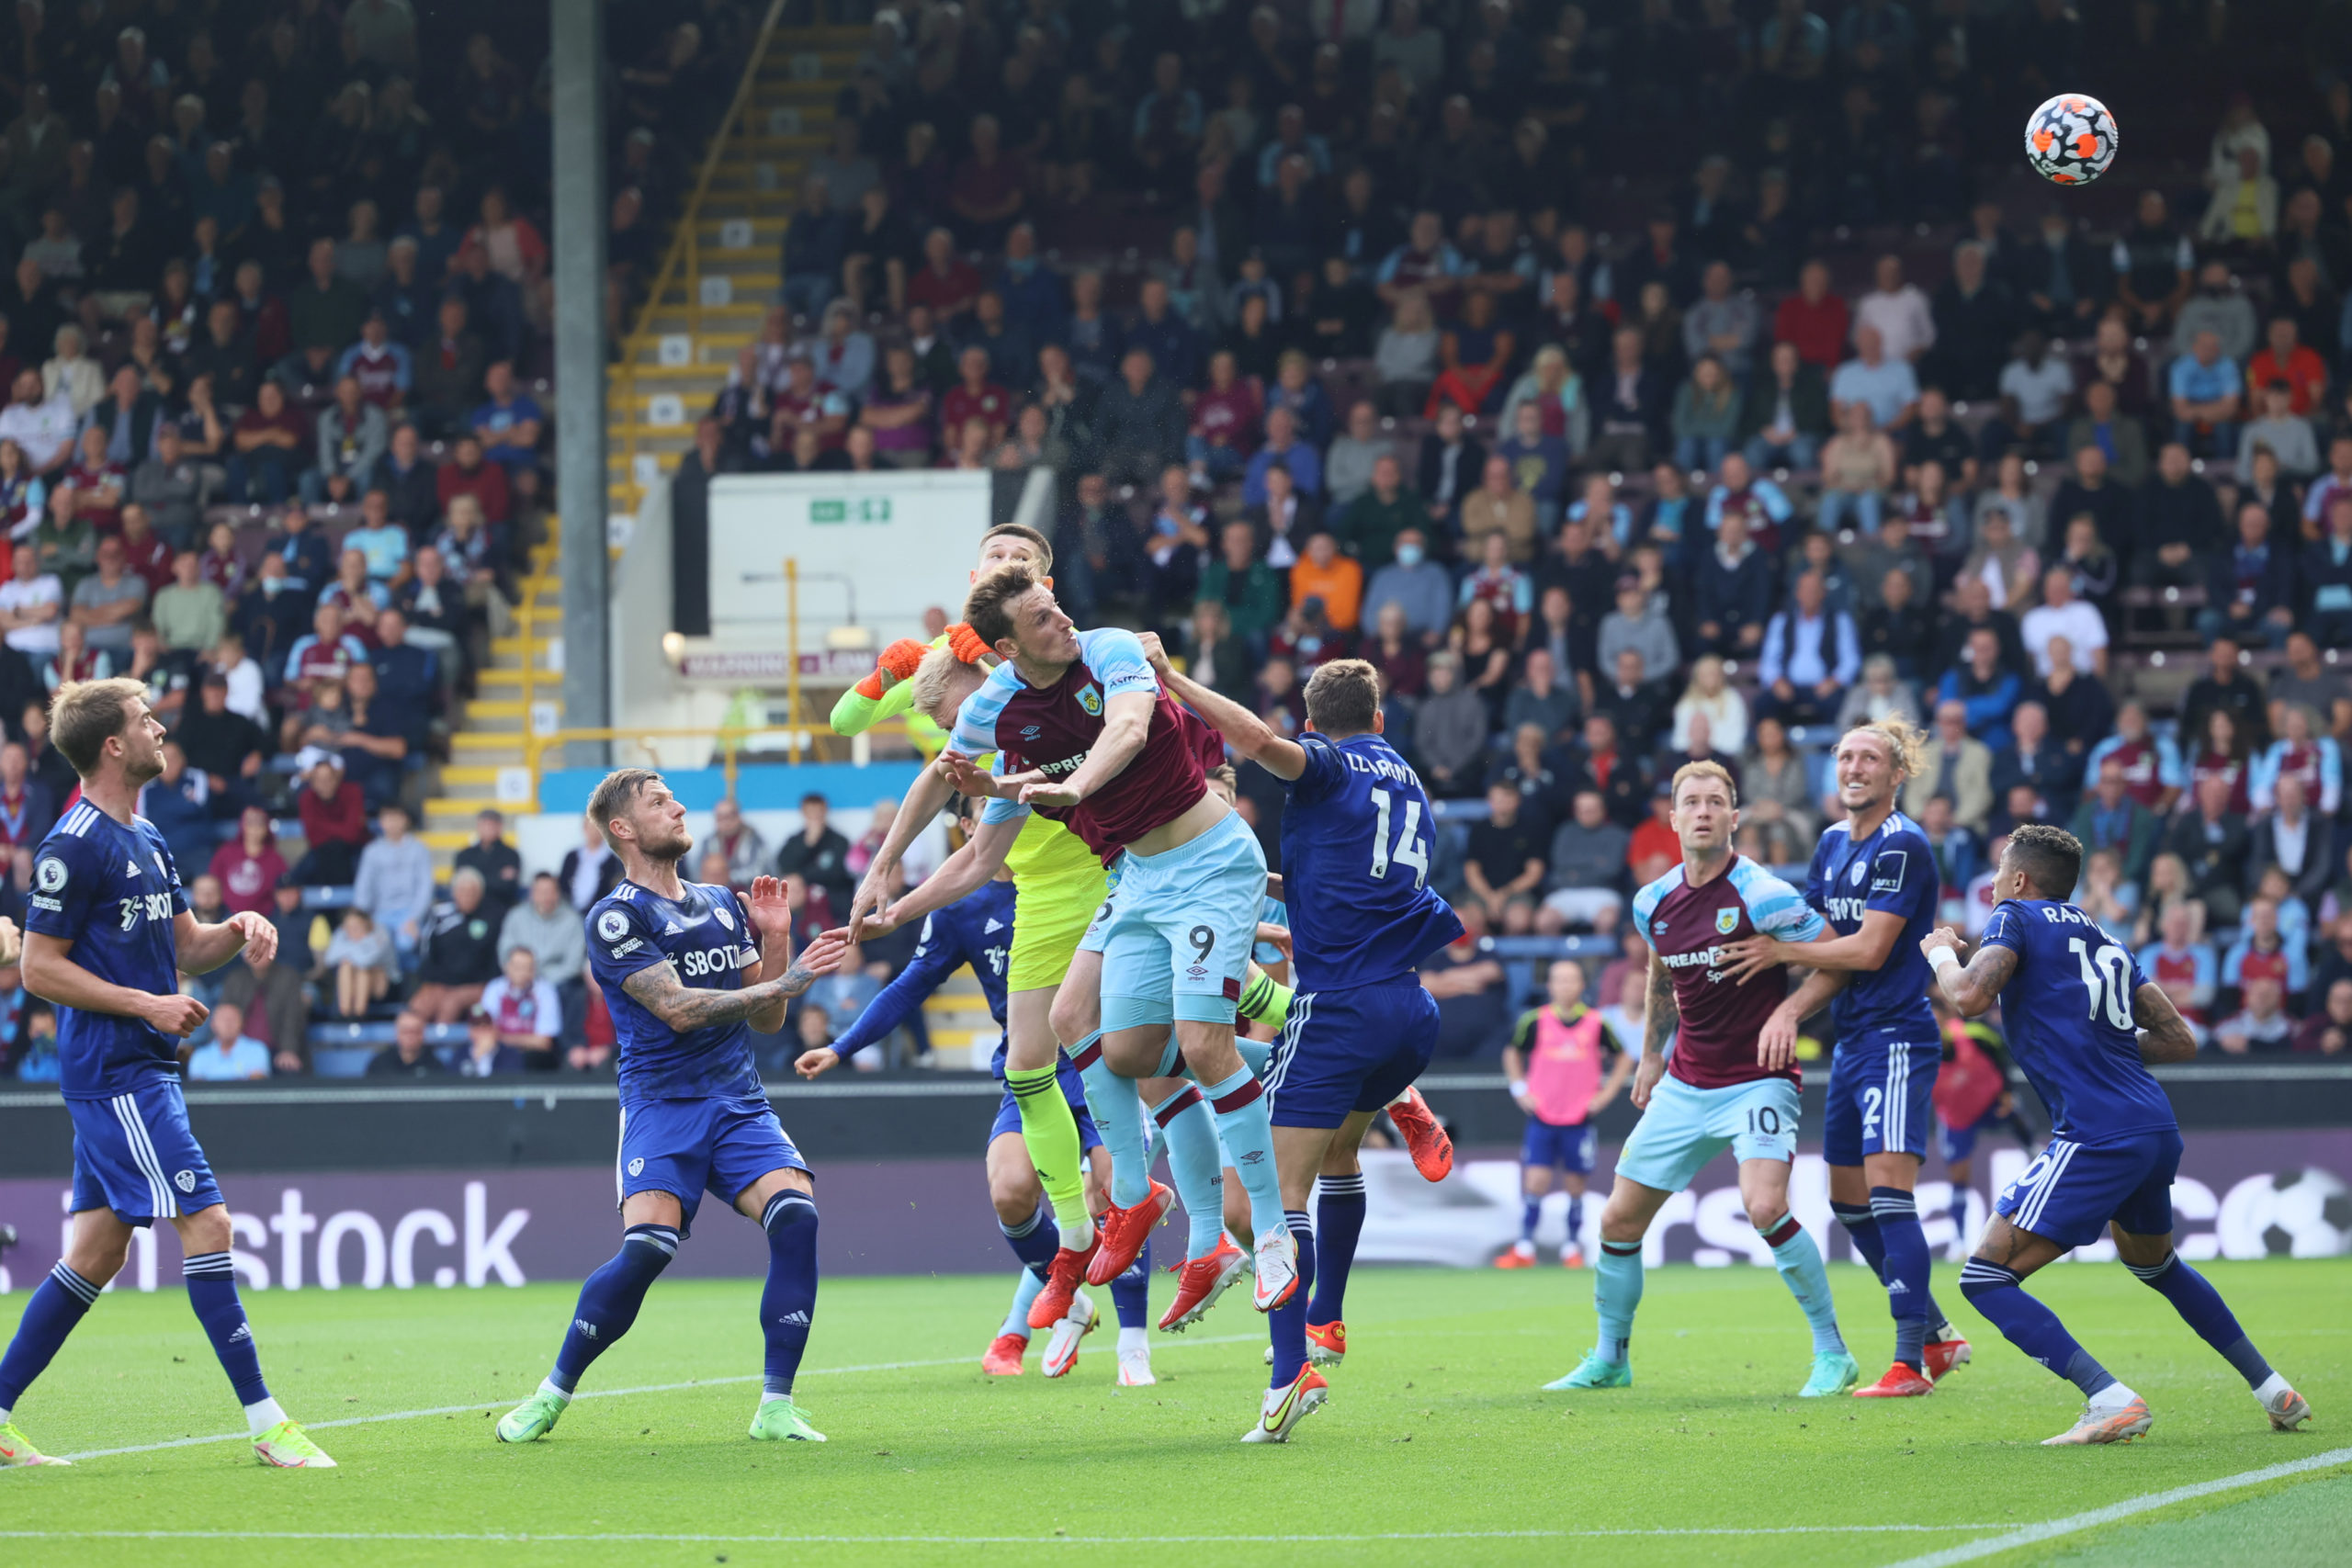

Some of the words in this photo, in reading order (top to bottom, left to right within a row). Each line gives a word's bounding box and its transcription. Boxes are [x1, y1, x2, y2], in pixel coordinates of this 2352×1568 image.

[1370, 787, 1428, 891] 14
[1189, 924, 1216, 964] 9
[2068, 937, 2134, 1031] 10
[1747, 1106, 1781, 1135] 10
[1862, 1087, 1883, 1125] 2
[230, 1181, 531, 1292] stock
